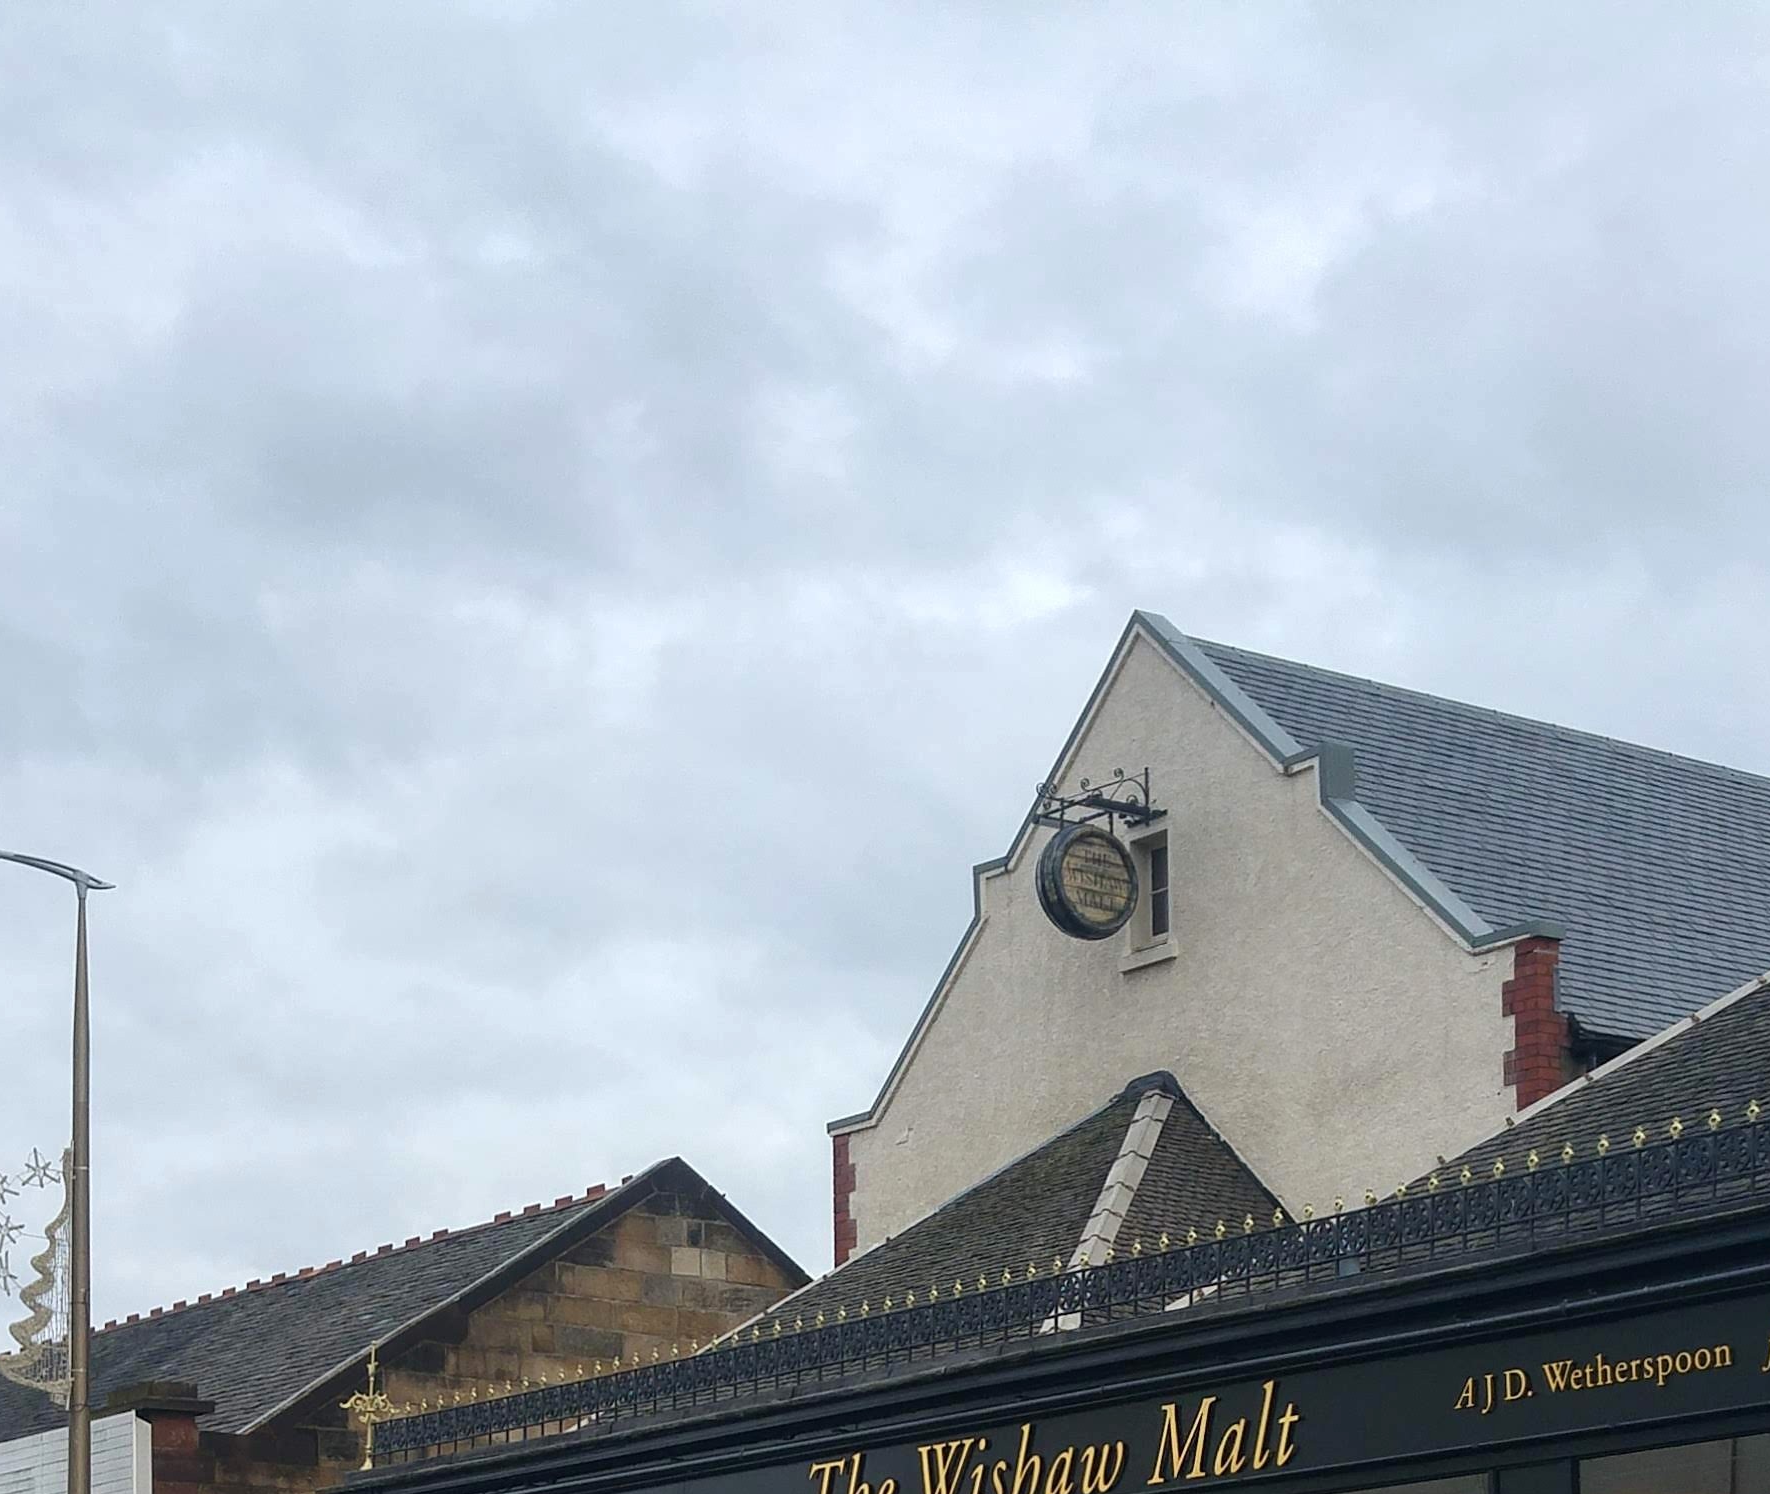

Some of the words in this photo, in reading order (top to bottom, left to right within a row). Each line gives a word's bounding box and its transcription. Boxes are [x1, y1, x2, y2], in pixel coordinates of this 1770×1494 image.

[1453, 1377, 1475, 1409] A
[1542, 1344, 1732, 1393] Wetherspoon
[1146, 1380, 1301, 1485] Malt
